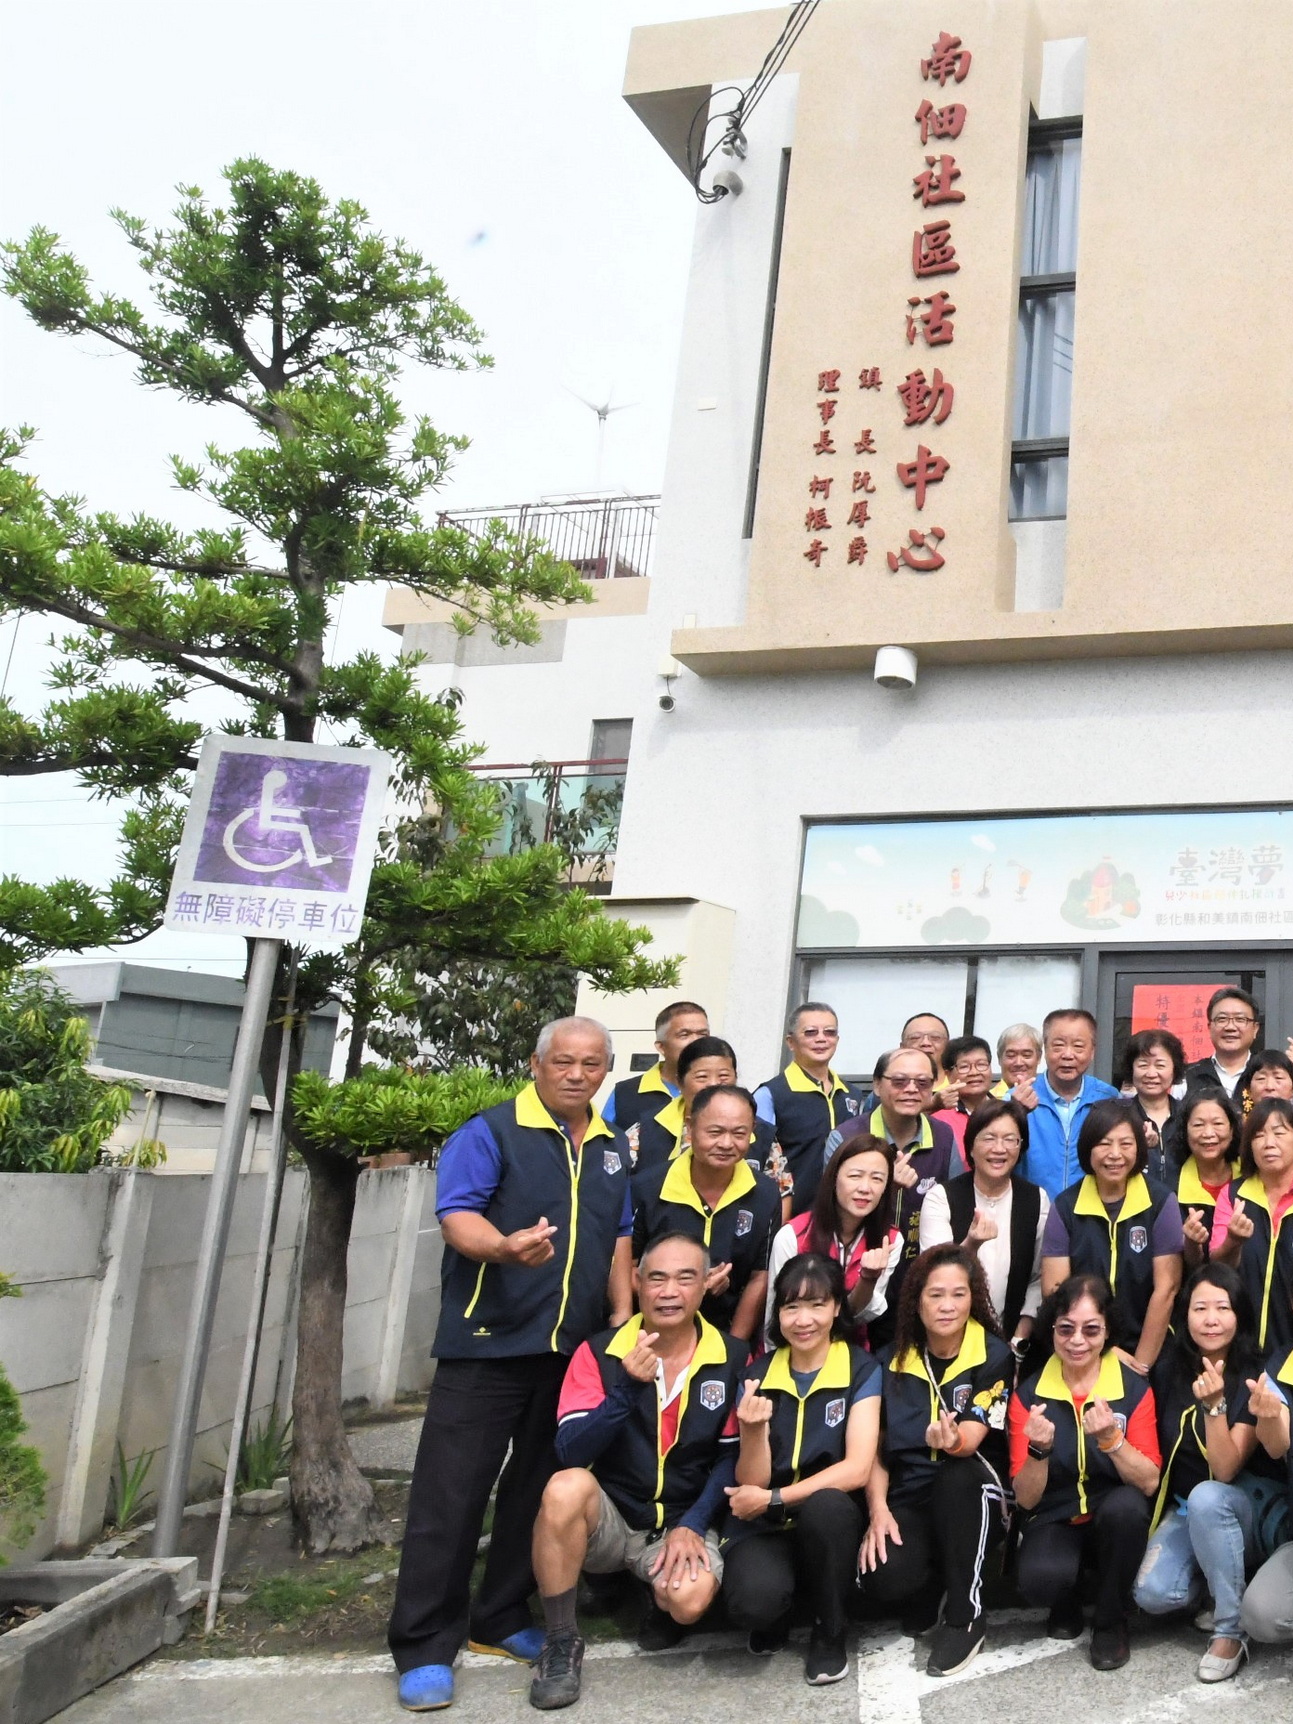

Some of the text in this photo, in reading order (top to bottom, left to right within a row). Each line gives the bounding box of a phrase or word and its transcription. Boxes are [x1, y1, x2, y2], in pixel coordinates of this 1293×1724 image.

[887, 31, 972, 573] 南佃社區活動中心
[813, 369, 841, 455] 理事長
[1168, 844, 1285, 887] 臺灣夢
[172, 891, 359, 934] 無障礙停車位
